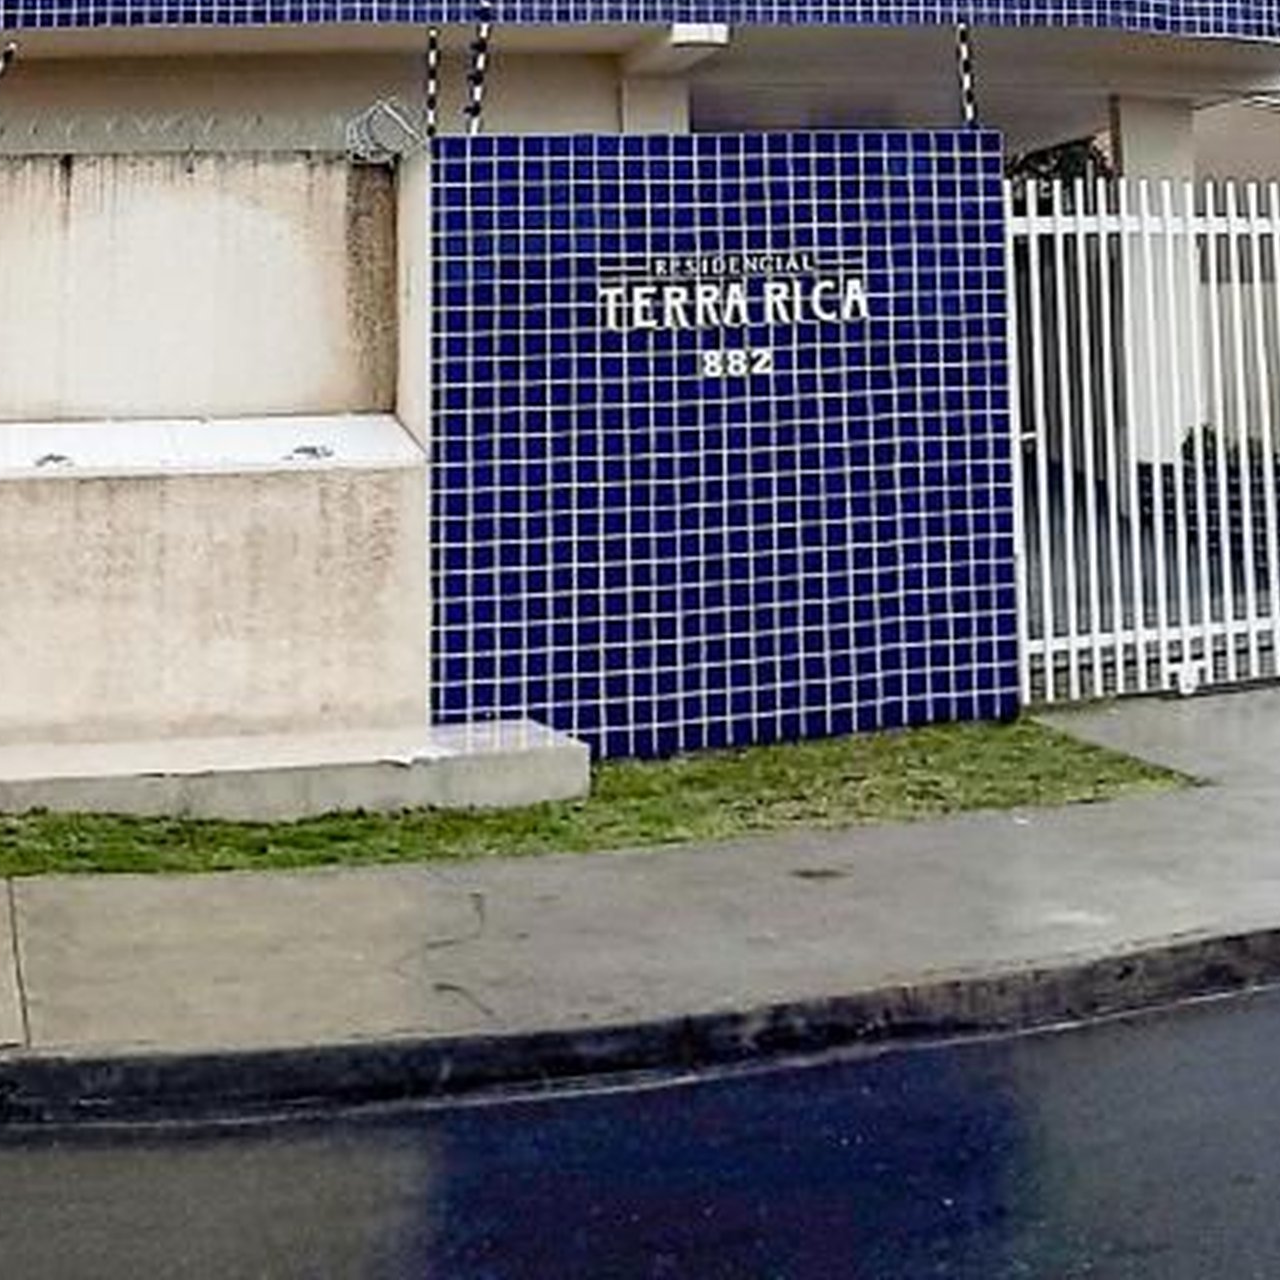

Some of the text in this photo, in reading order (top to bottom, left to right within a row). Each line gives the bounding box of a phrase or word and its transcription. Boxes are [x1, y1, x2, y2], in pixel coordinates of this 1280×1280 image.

[655, 255, 814, 276] RESIDENCIAL
[600, 280, 869, 329] TERRA RICA
[702, 350, 773, 377] 882
